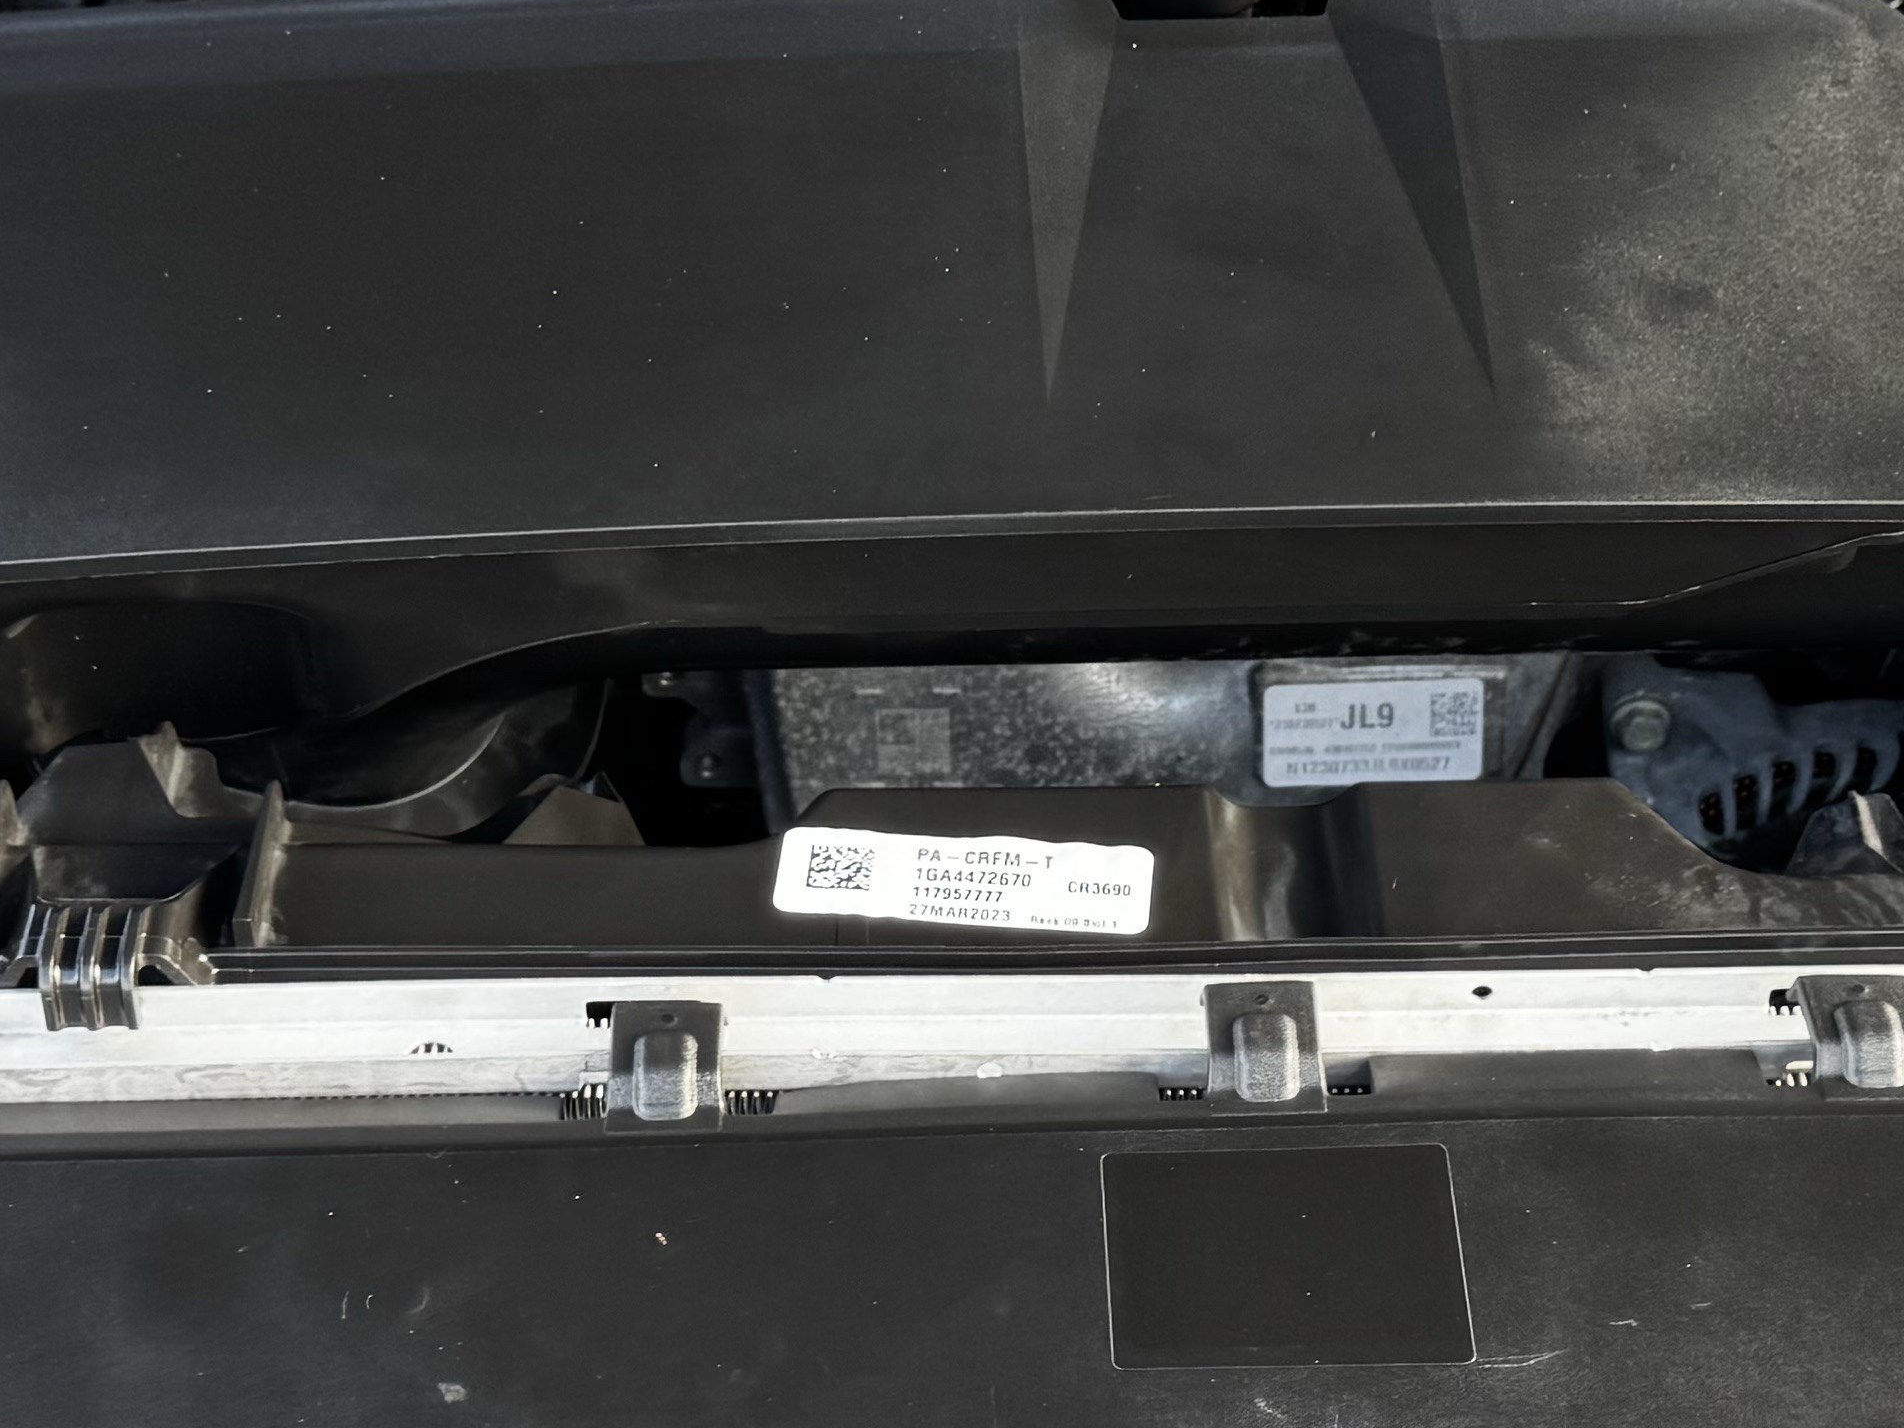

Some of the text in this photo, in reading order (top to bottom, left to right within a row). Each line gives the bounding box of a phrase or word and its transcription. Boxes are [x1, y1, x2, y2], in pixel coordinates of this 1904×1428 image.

[1340, 702, 1395, 731] JL9
[916, 868, 1032, 887] 1GA4472670
[913, 886, 1003, 902] 117957777
[1068, 880, 1131, 897] CR3690
[909, 903, 1011, 922] 27MAR2023
